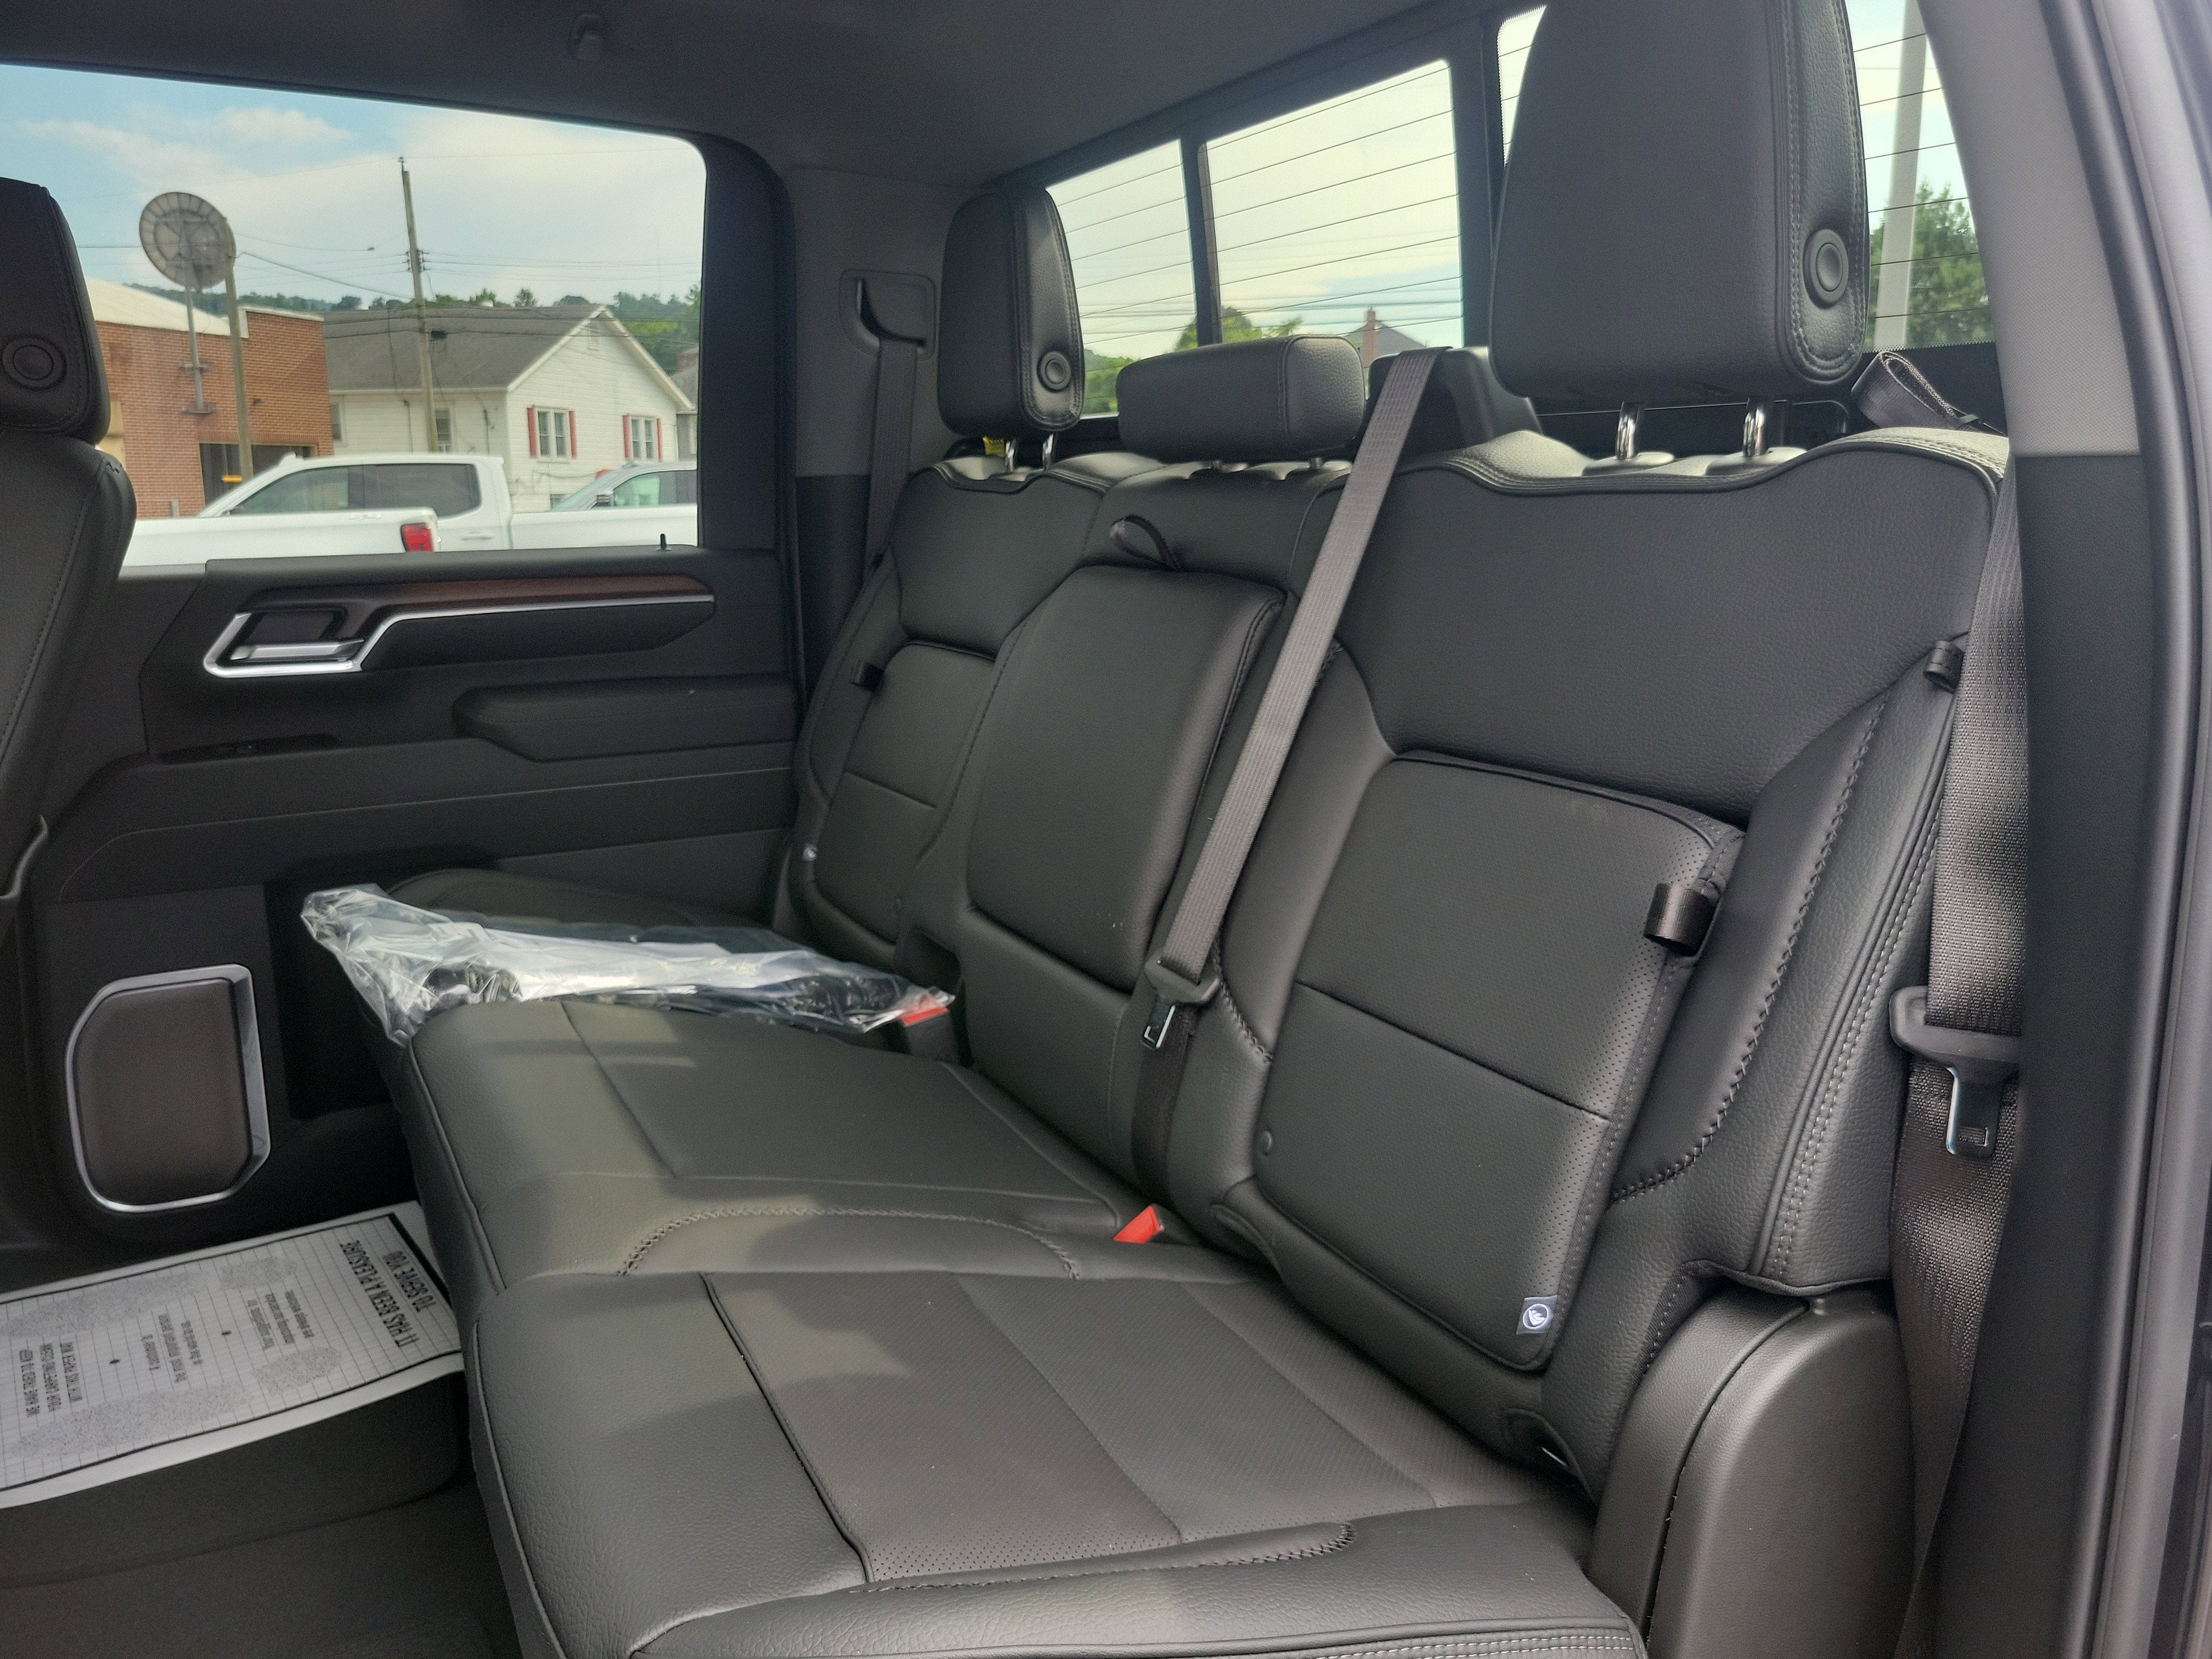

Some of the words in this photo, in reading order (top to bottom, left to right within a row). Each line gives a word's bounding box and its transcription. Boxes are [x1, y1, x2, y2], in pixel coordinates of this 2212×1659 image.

[340, 1240, 381, 1285] PLEASURE
[383, 1250, 411, 1272] YOU
[364, 1281, 387, 1292] A
[393, 1267, 429, 1299] SERVE
[369, 1290, 400, 1316] BEEN
[412, 1295, 437, 1312] TO
[383, 1313, 413, 1337] HAS
[394, 1333, 420, 1348] IT
